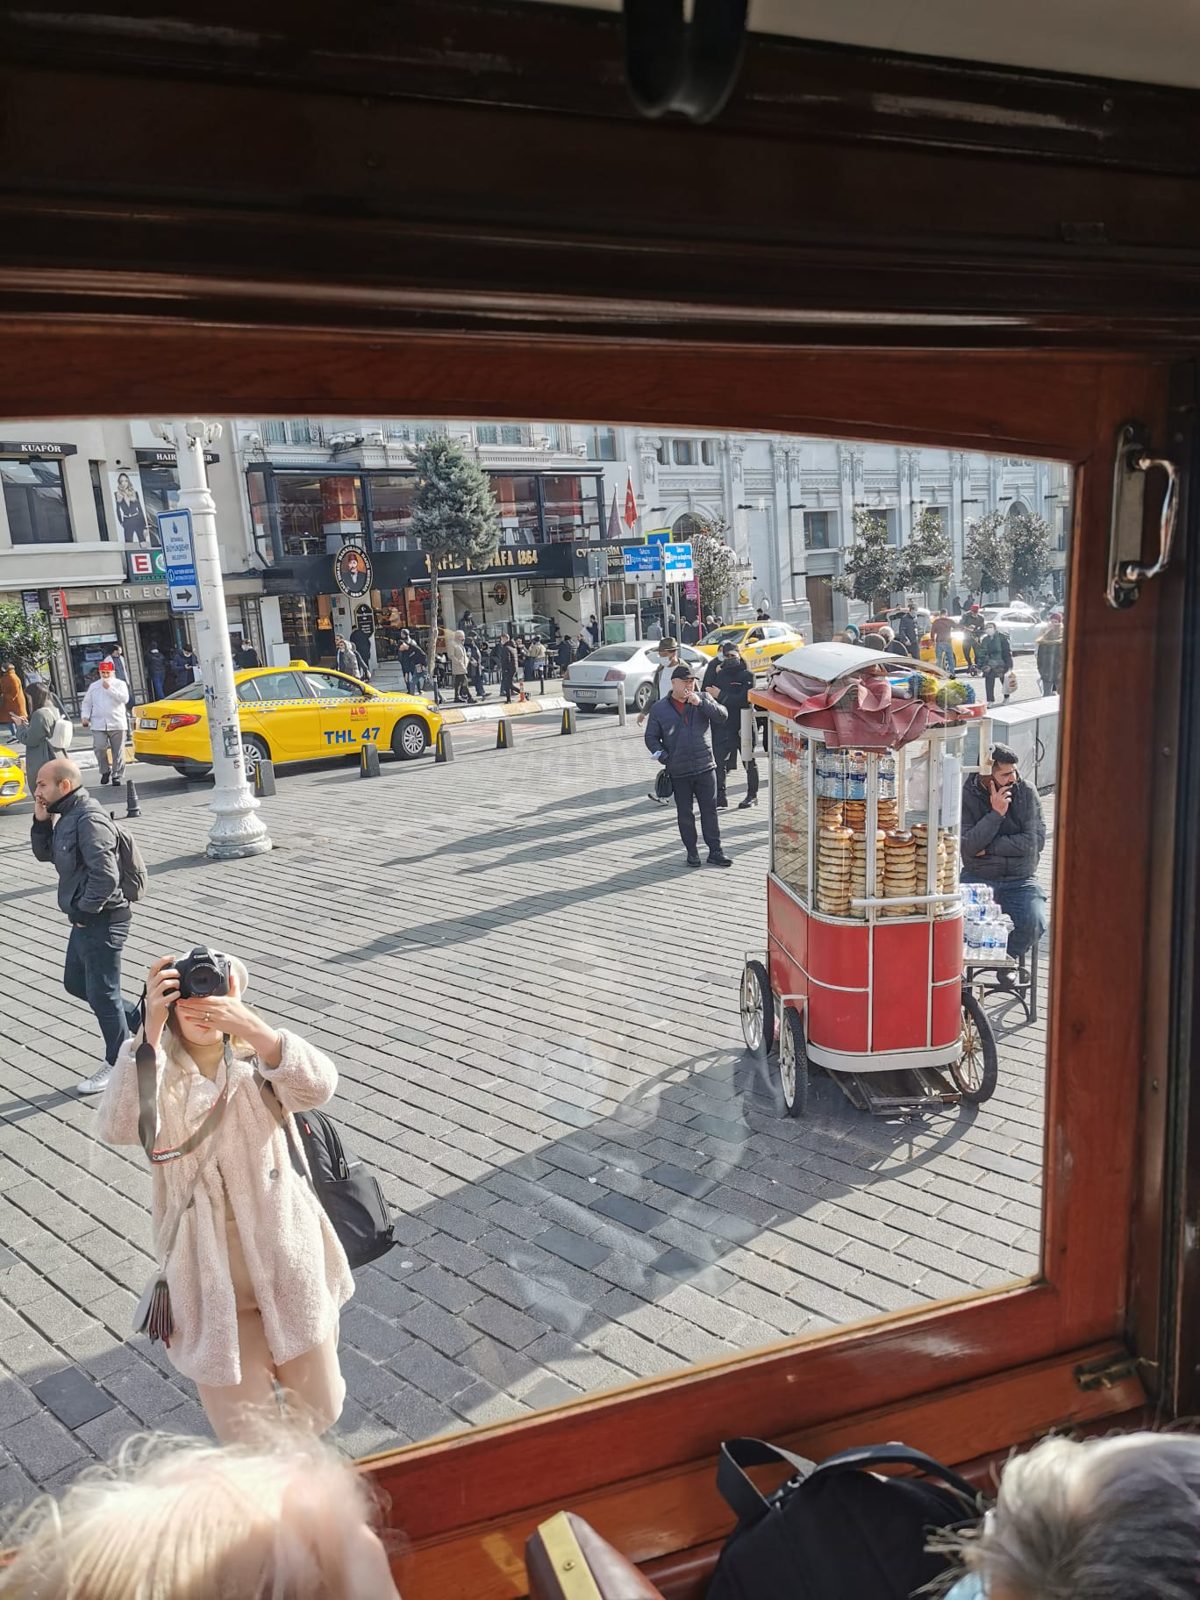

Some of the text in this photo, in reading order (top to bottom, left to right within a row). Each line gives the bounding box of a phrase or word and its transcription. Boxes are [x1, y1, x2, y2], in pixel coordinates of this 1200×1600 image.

[21, 444, 62, 453] KUAFÖR
[324, 726, 381, 745] THL 47
